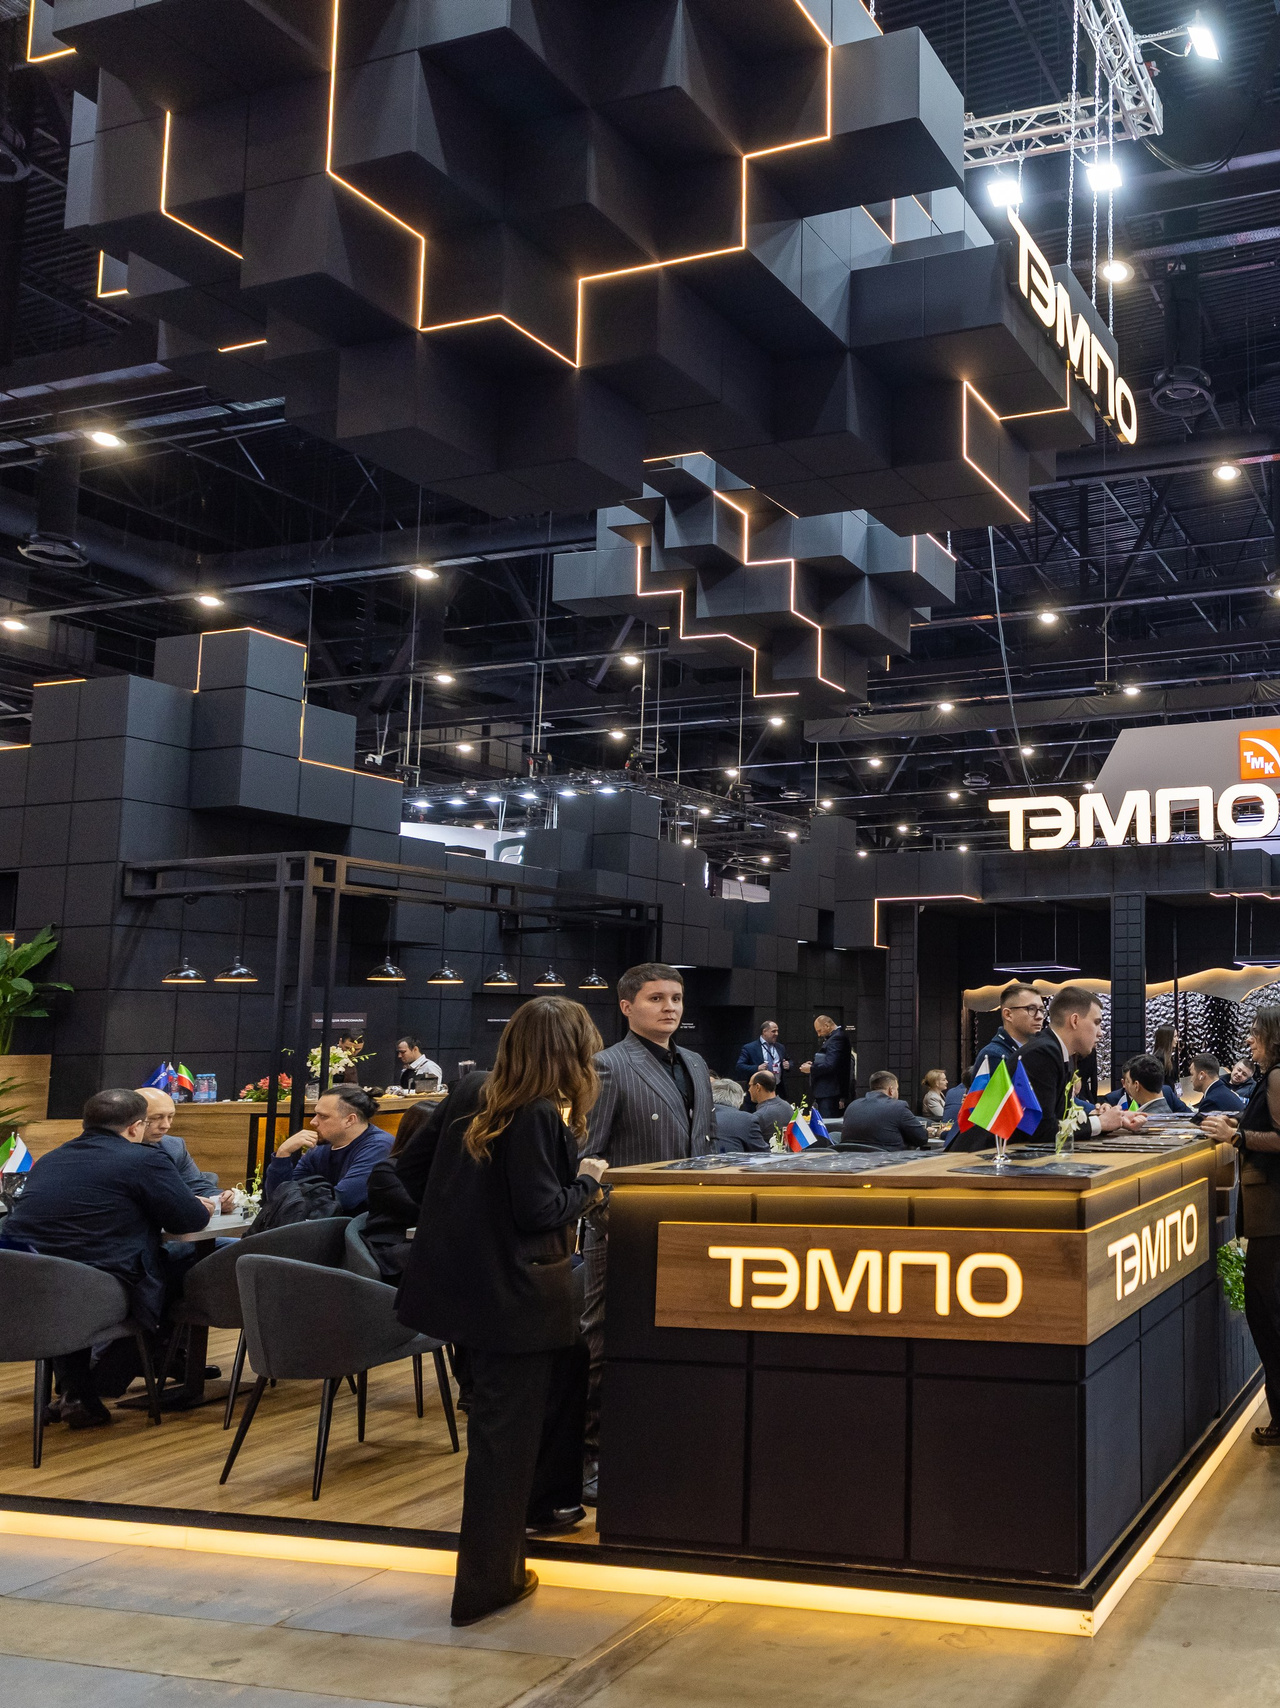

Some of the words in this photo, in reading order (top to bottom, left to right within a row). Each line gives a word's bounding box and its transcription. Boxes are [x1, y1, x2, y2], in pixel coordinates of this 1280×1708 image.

[1007, 206, 1137, 444] ТЭМПО
[1243, 751, 1275, 775] ТМК
[988, 783, 1280, 851] ТЭМПО
[708, 1245, 1023, 1319] ТЭМПО
[1107, 1203, 1198, 1301] ТЭМПО
